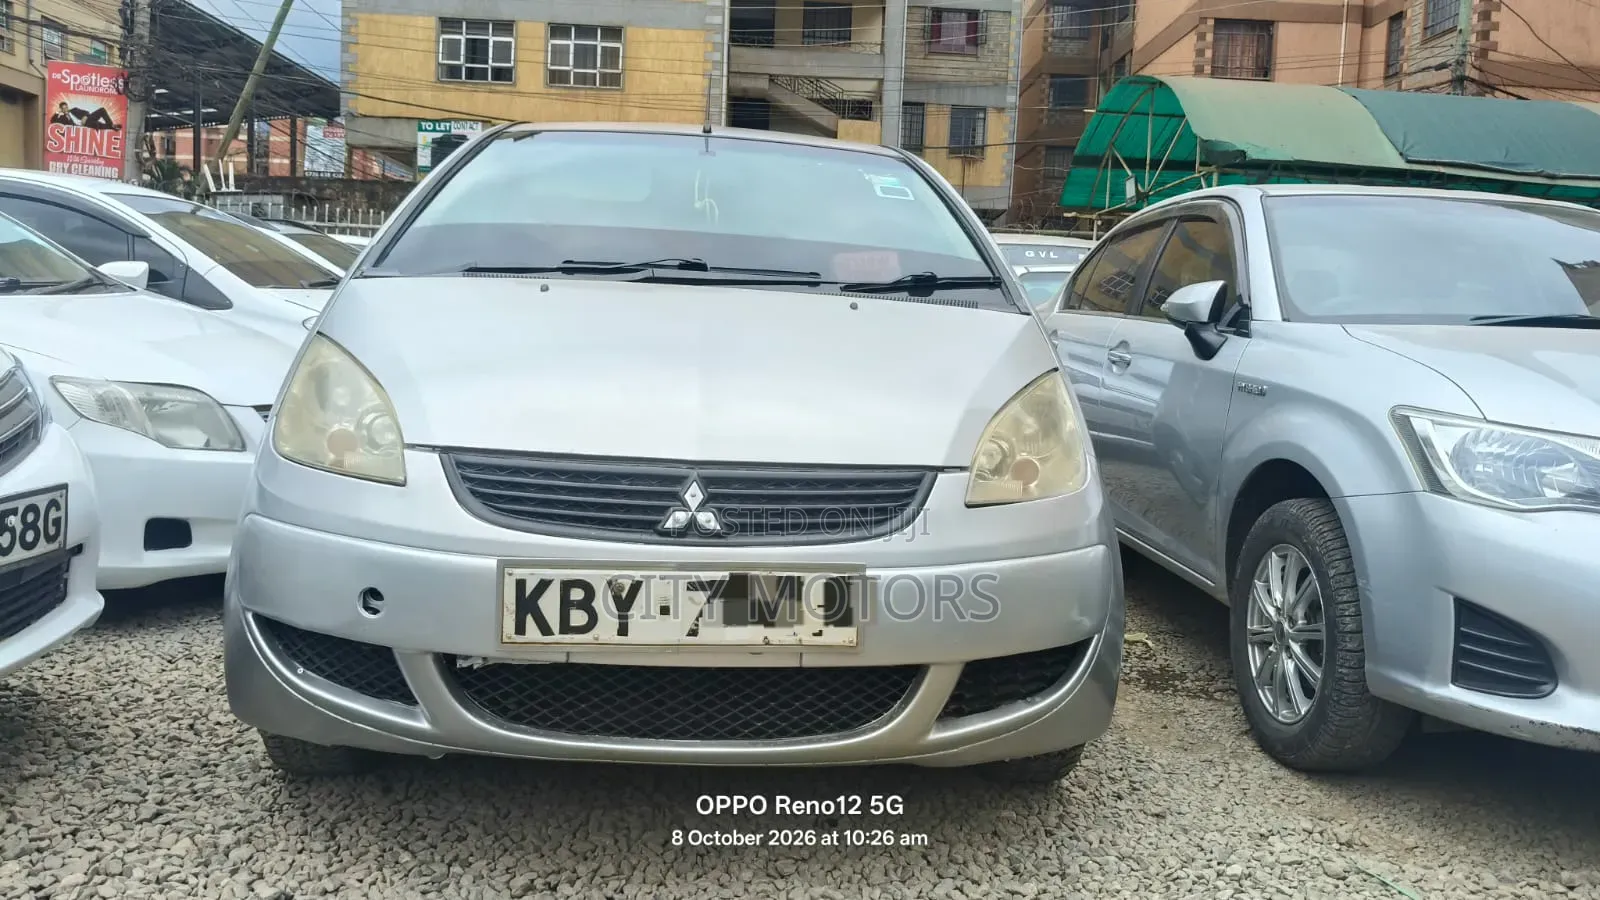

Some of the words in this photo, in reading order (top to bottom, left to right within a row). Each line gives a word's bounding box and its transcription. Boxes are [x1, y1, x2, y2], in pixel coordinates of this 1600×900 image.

[421, 122, 434, 130] TO
[436, 122, 451, 131] LET
[47, 122, 122, 159] SHINE
[49, 161, 70, 173] DRY
[71, 164, 119, 179] CLEANING
[514, 578, 643, 637] KBY
